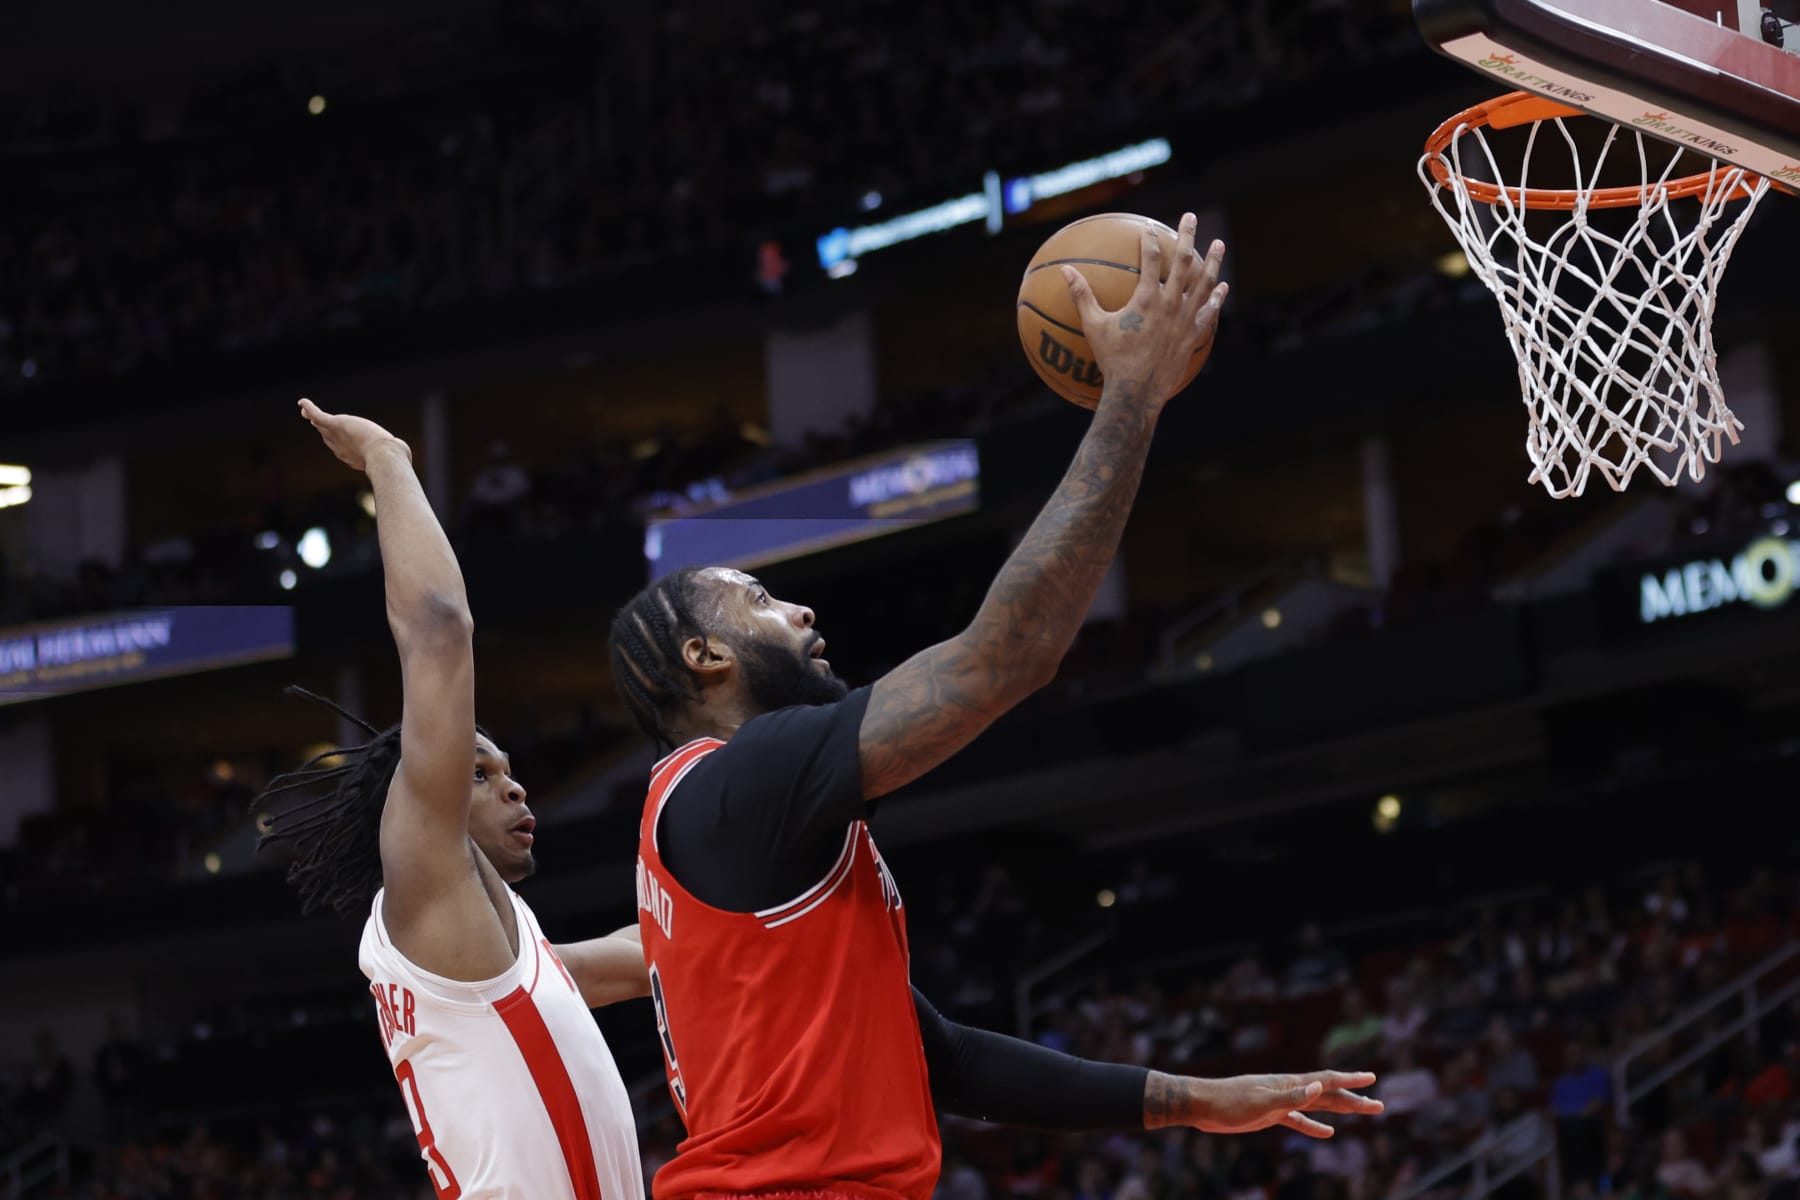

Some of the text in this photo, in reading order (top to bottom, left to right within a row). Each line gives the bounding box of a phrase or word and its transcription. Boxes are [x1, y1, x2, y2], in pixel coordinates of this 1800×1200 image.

[1478, 59, 1596, 102] DRAFTKINGS
[1632, 117, 1738, 155] DRAFTKINGS
[1040, 329, 1105, 388] Wil
[1640, 536, 1800, 624] MEMO
